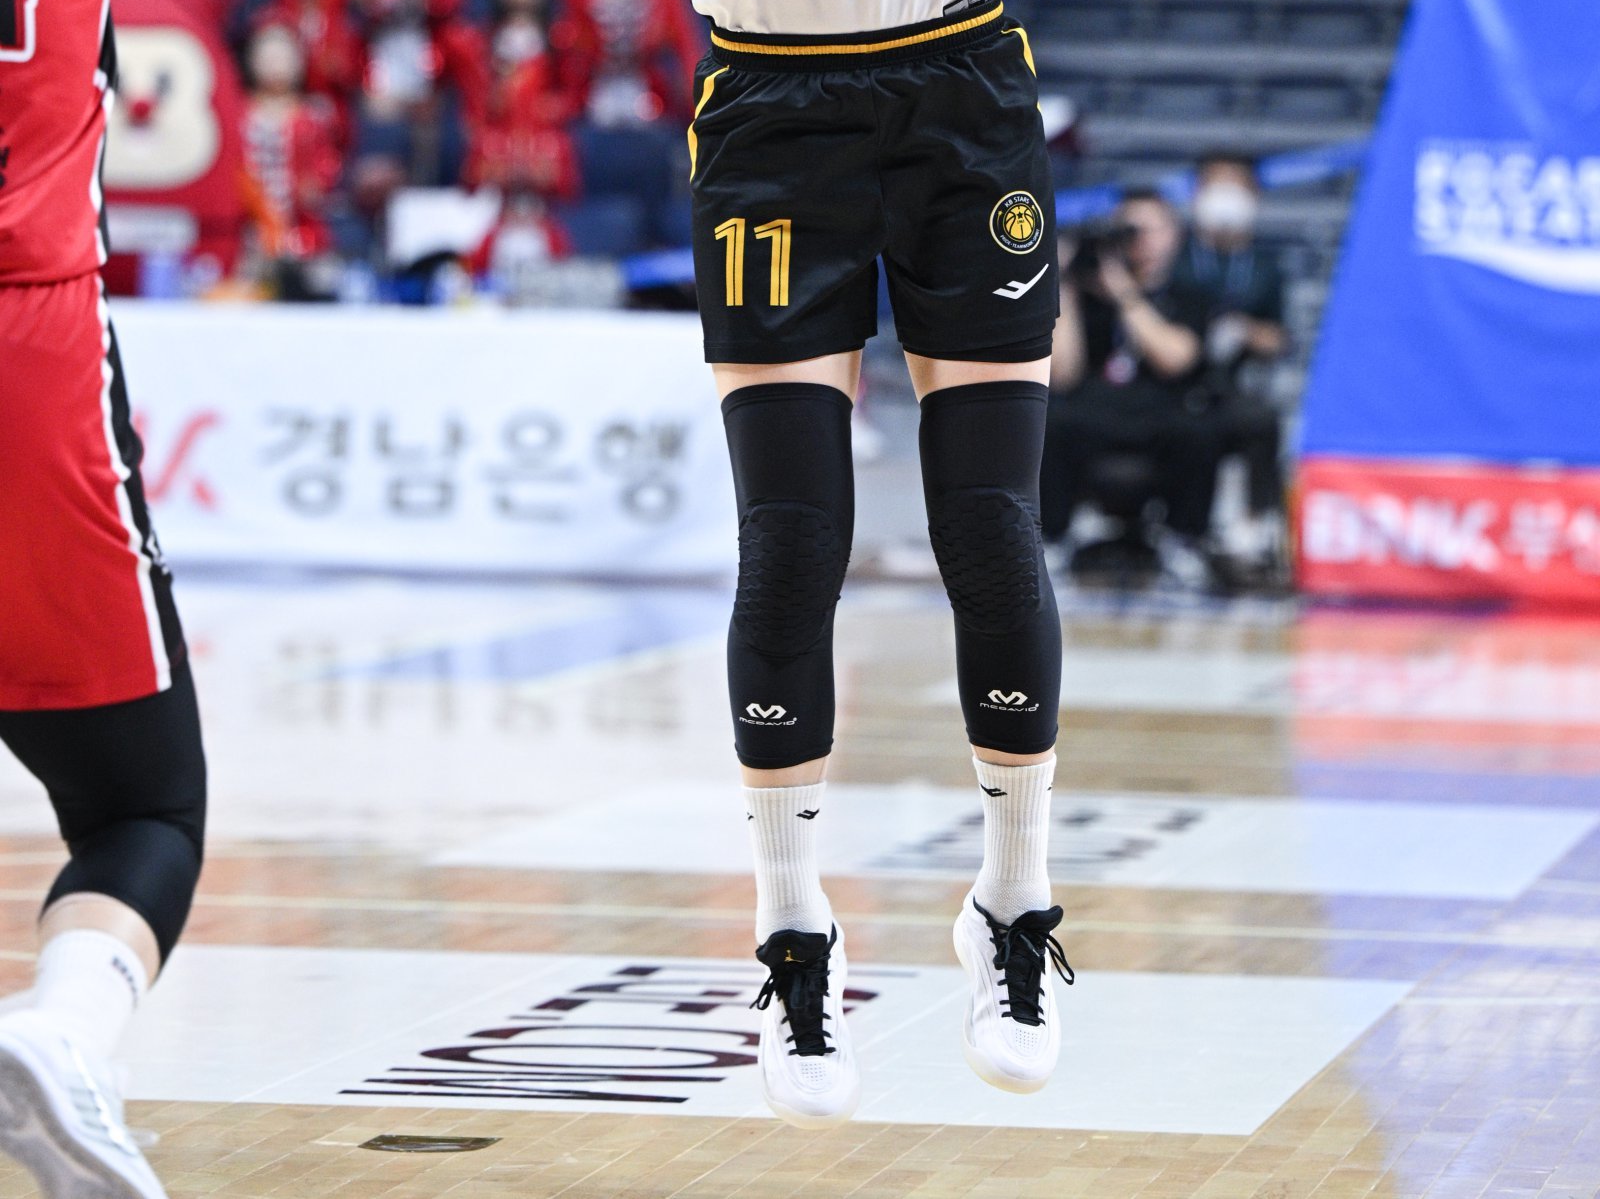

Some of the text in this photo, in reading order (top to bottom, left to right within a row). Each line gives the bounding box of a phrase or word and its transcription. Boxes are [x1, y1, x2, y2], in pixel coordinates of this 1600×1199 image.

[1013, 196, 1030, 205] STARS
[714, 217, 791, 307] 11
[260, 407, 689, 522] 경남은행
